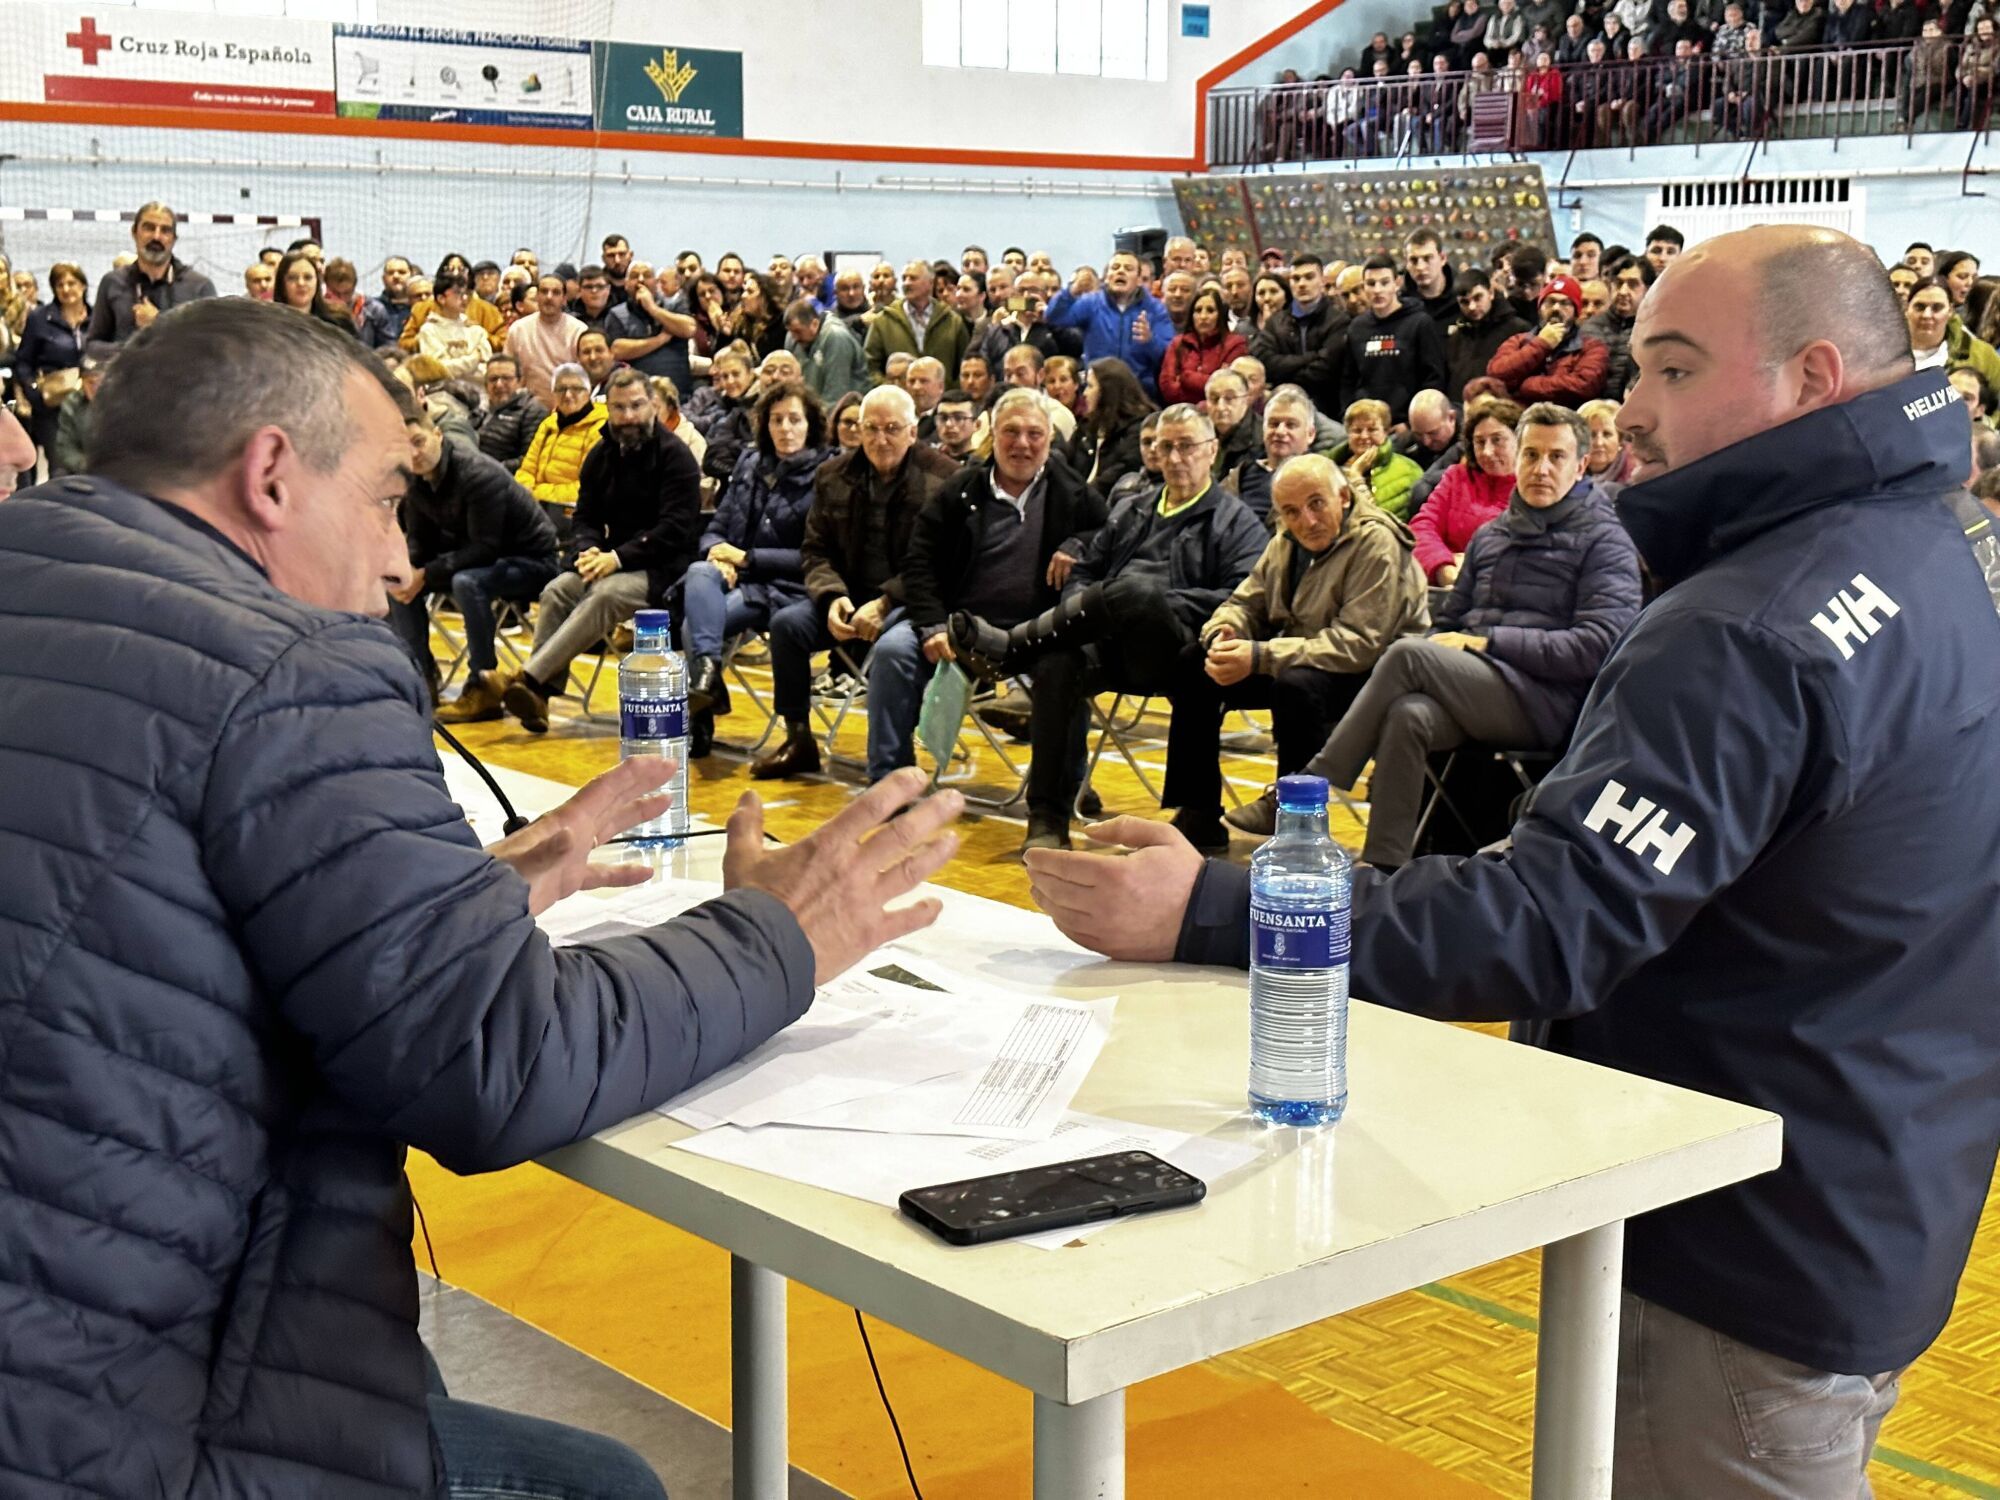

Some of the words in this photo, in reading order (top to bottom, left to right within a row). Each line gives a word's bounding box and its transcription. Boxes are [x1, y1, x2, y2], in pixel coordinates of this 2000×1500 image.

[119, 36, 169, 56] Cruz
[175, 40, 219, 61] Roja
[225, 44, 312, 65] Española
[626, 105, 663, 123] CAJA
[666, 107, 716, 125] RURAL
[1902, 389, 1947, 421] HELLY
[1810, 573, 1901, 661] HH
[624, 702, 681, 714] FUENSANTA
[1582, 779, 1697, 876] HH
